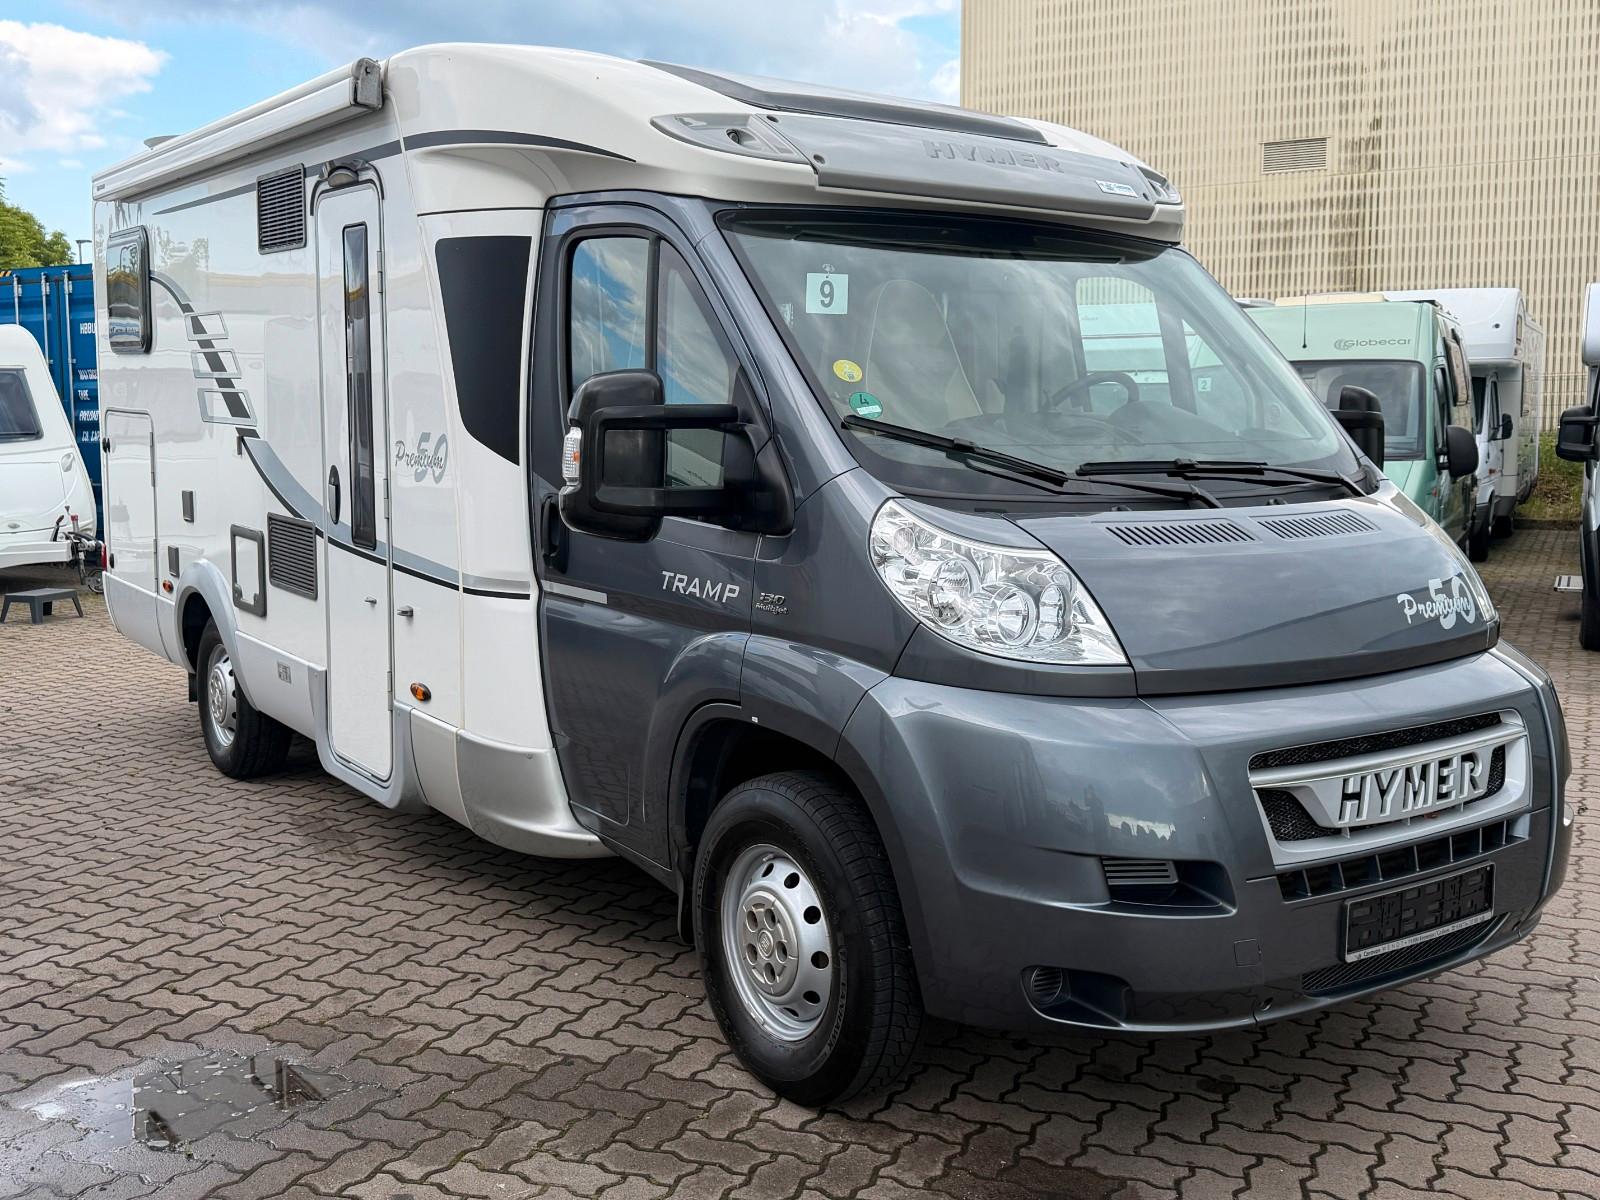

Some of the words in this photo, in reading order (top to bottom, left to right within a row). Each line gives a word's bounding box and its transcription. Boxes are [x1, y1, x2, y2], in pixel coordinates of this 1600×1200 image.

[922, 140, 1065, 174] HYMER
[819, 279, 835, 308] 9
[1343, 337, 1412, 350] Globecar
[394, 439, 445, 469] Premium
[414, 431, 449, 485] 50
[661, 570, 740, 603] TRAMP
[1427, 575, 1476, 630] 50
[1396, 593, 1473, 625] Premium
[1338, 751, 1484, 825] HYMER
